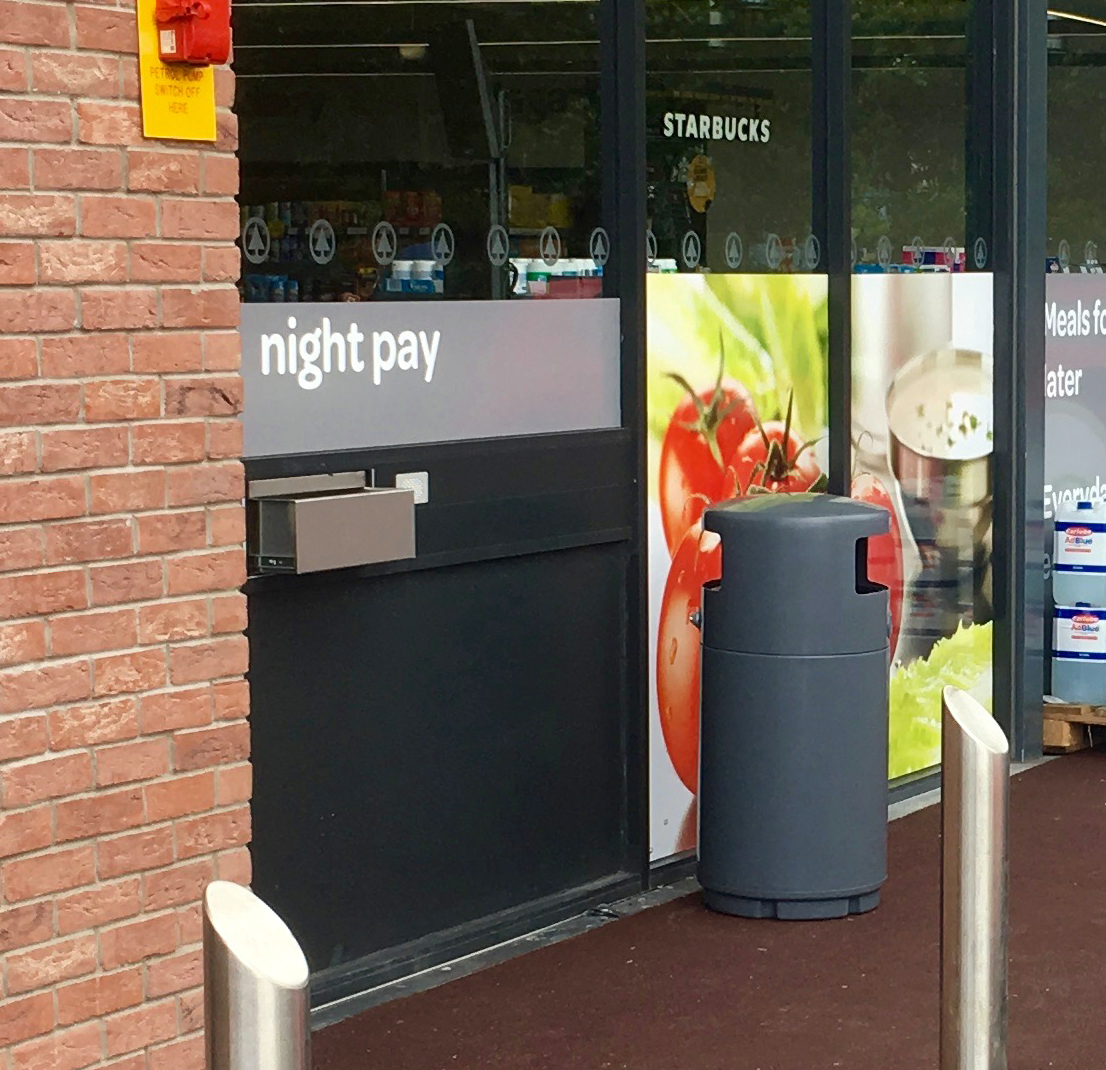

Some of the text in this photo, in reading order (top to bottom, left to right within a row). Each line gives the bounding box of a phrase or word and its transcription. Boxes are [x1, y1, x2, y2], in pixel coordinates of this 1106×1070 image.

[155, 83, 201, 99] SWITCH OFF
[168, 101, 189, 115] HERE
[663, 111, 771, 143] STARBUCKS
[1045, 300, 1091, 337] Meals
[261, 316, 441, 390] night pay
[1064, 536, 1093, 545] AdBlue
